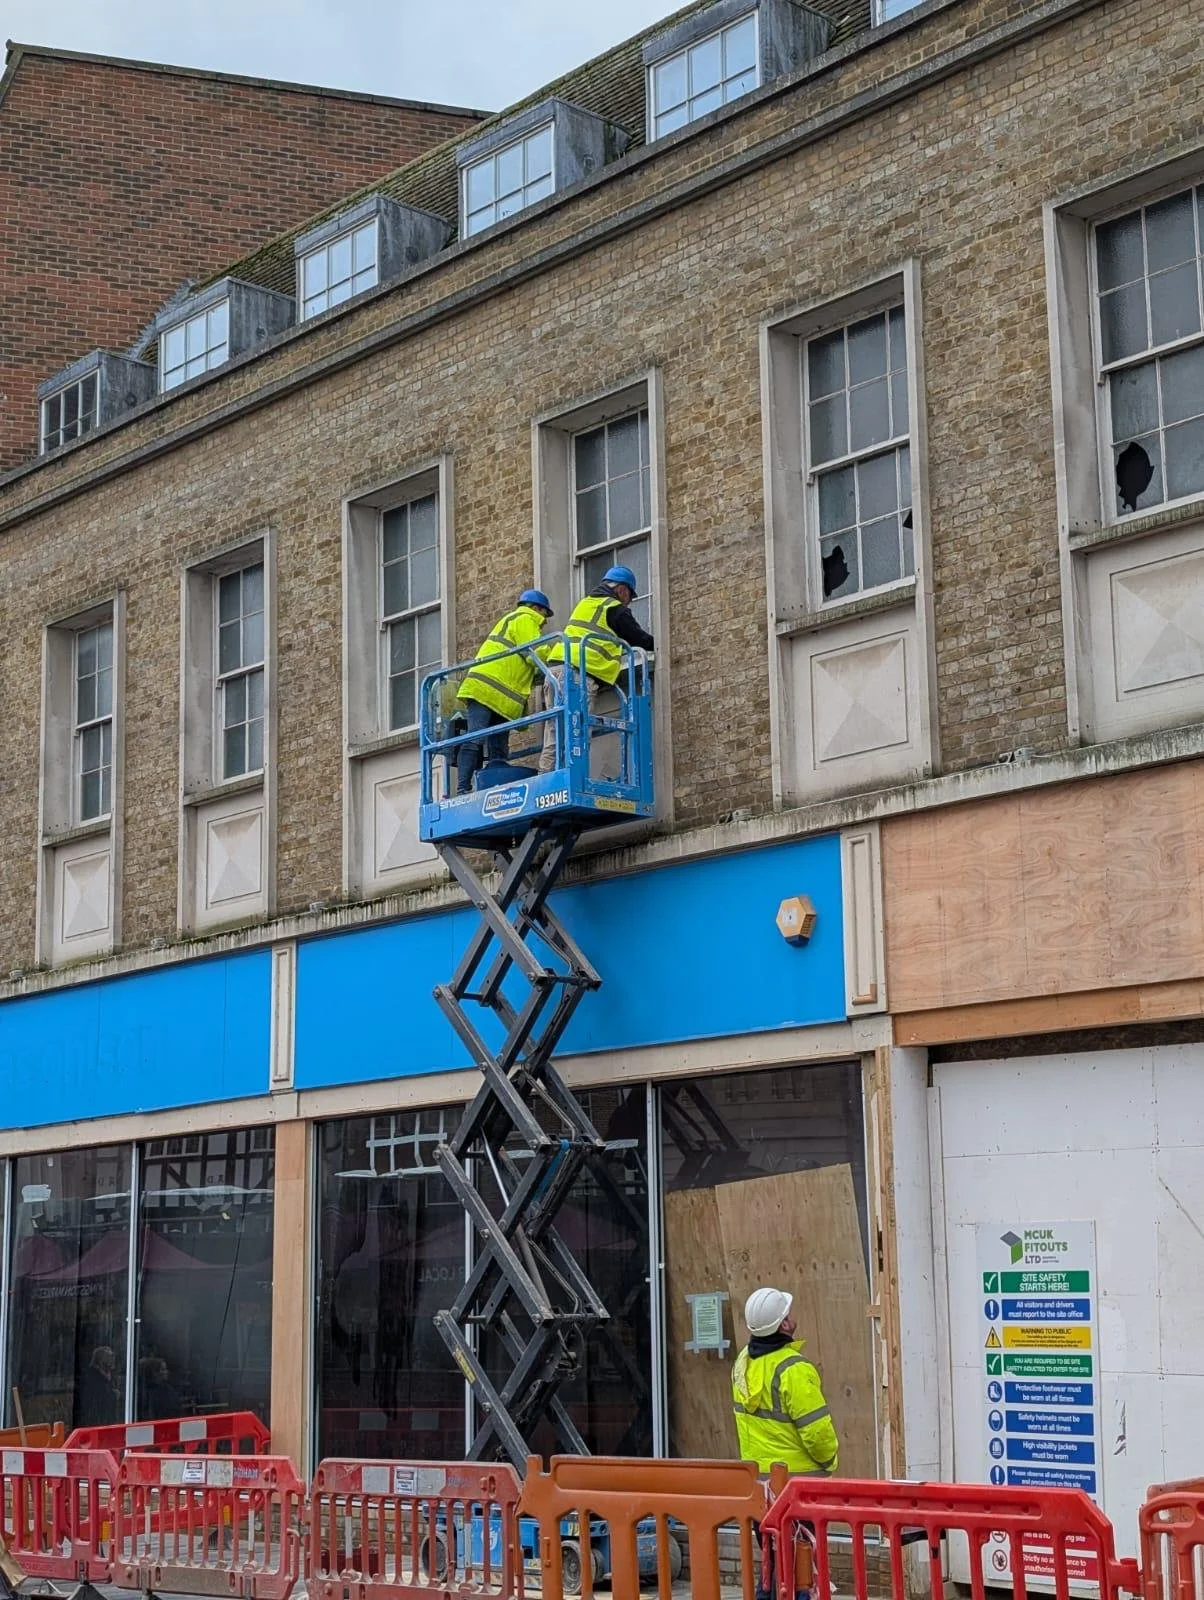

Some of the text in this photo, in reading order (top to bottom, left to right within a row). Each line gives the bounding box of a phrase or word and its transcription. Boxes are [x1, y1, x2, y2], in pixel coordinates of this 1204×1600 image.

[488, 796, 500, 807] HSS
[535, 790, 568, 808] 1932ME
[1024, 1230, 1053, 1240] MCUK
[1024, 1242, 1068, 1252] FITOUTS
[1025, 1256, 1041, 1264] LTD
[1022, 1273, 1066, 1282] SITE SAFETY
[1020, 1282, 1069, 1291] STARTS HERE!
[1018, 1413, 1035, 1422] Safety
[1022, 1441, 1078, 1451] High visibility jackets
